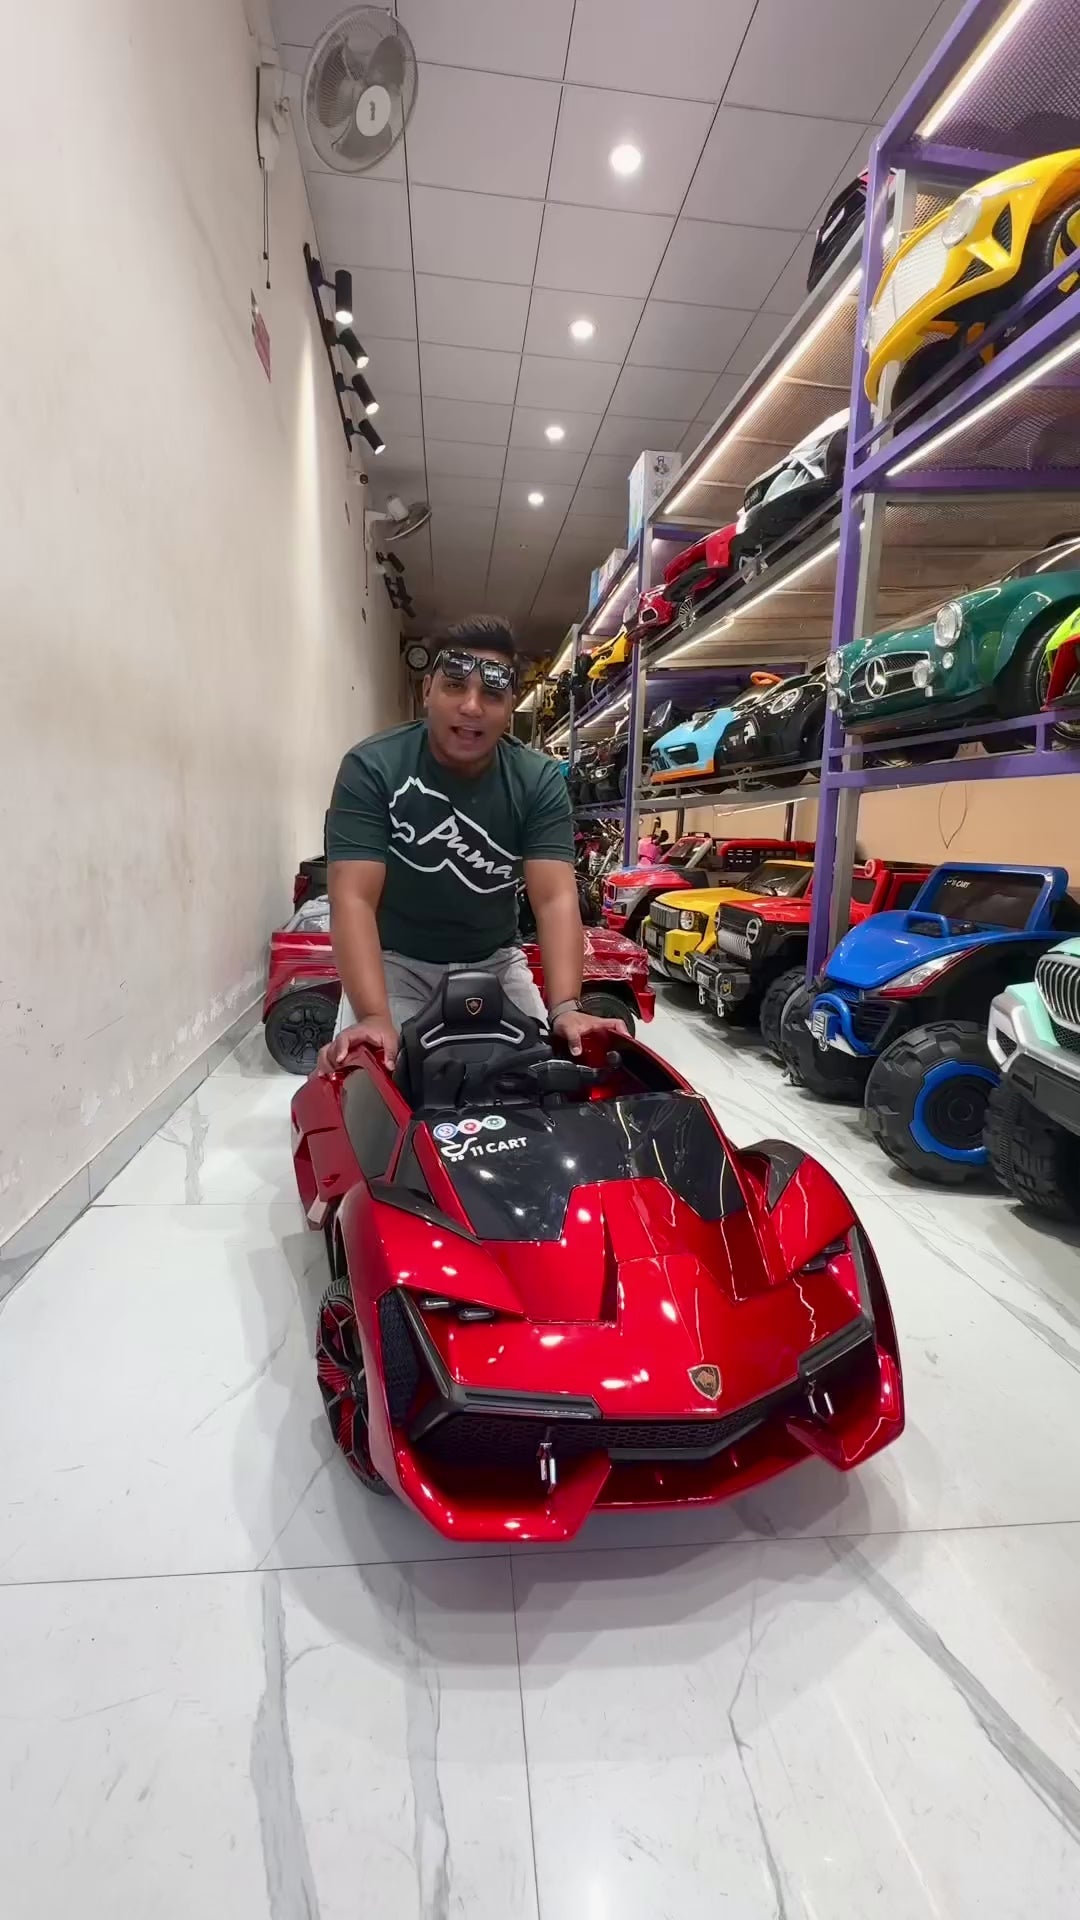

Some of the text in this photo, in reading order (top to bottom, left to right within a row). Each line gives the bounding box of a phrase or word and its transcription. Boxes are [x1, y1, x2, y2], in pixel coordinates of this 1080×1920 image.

[417, 815, 513, 879] Puma
[470, 1137, 527, 1157] 11 CART
